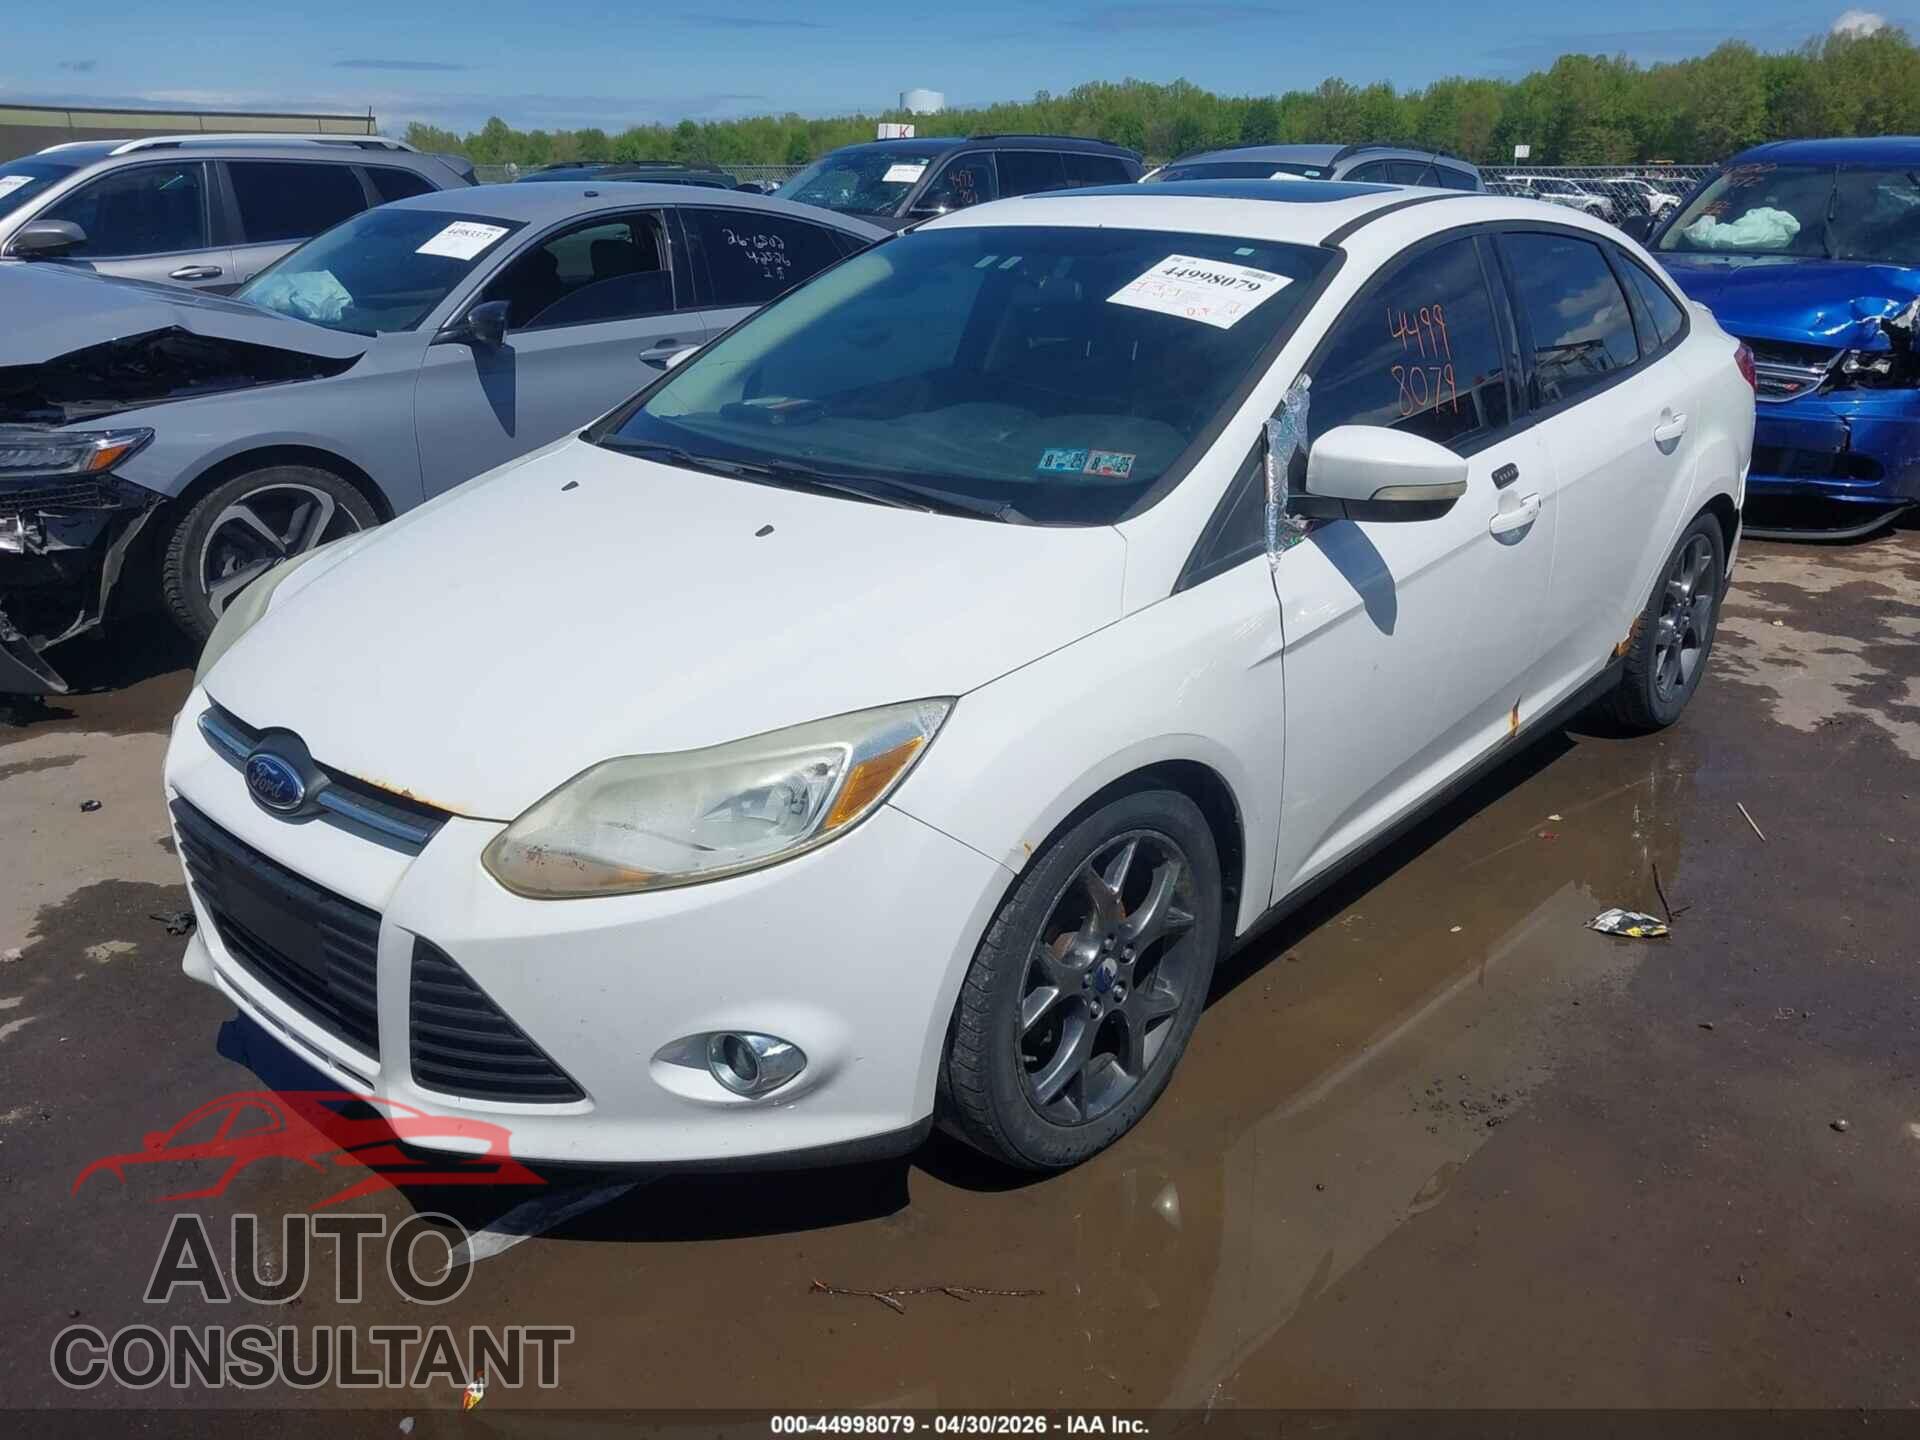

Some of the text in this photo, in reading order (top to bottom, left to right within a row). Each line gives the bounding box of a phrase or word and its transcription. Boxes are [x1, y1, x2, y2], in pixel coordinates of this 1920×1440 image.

[899, 125, 910, 138] K
[1161, 265, 1262, 292] 44998079
[1386, 304, 1452, 361] 4499
[1391, 363, 1458, 416] 8079
[251, 761, 285, 800] Ford
